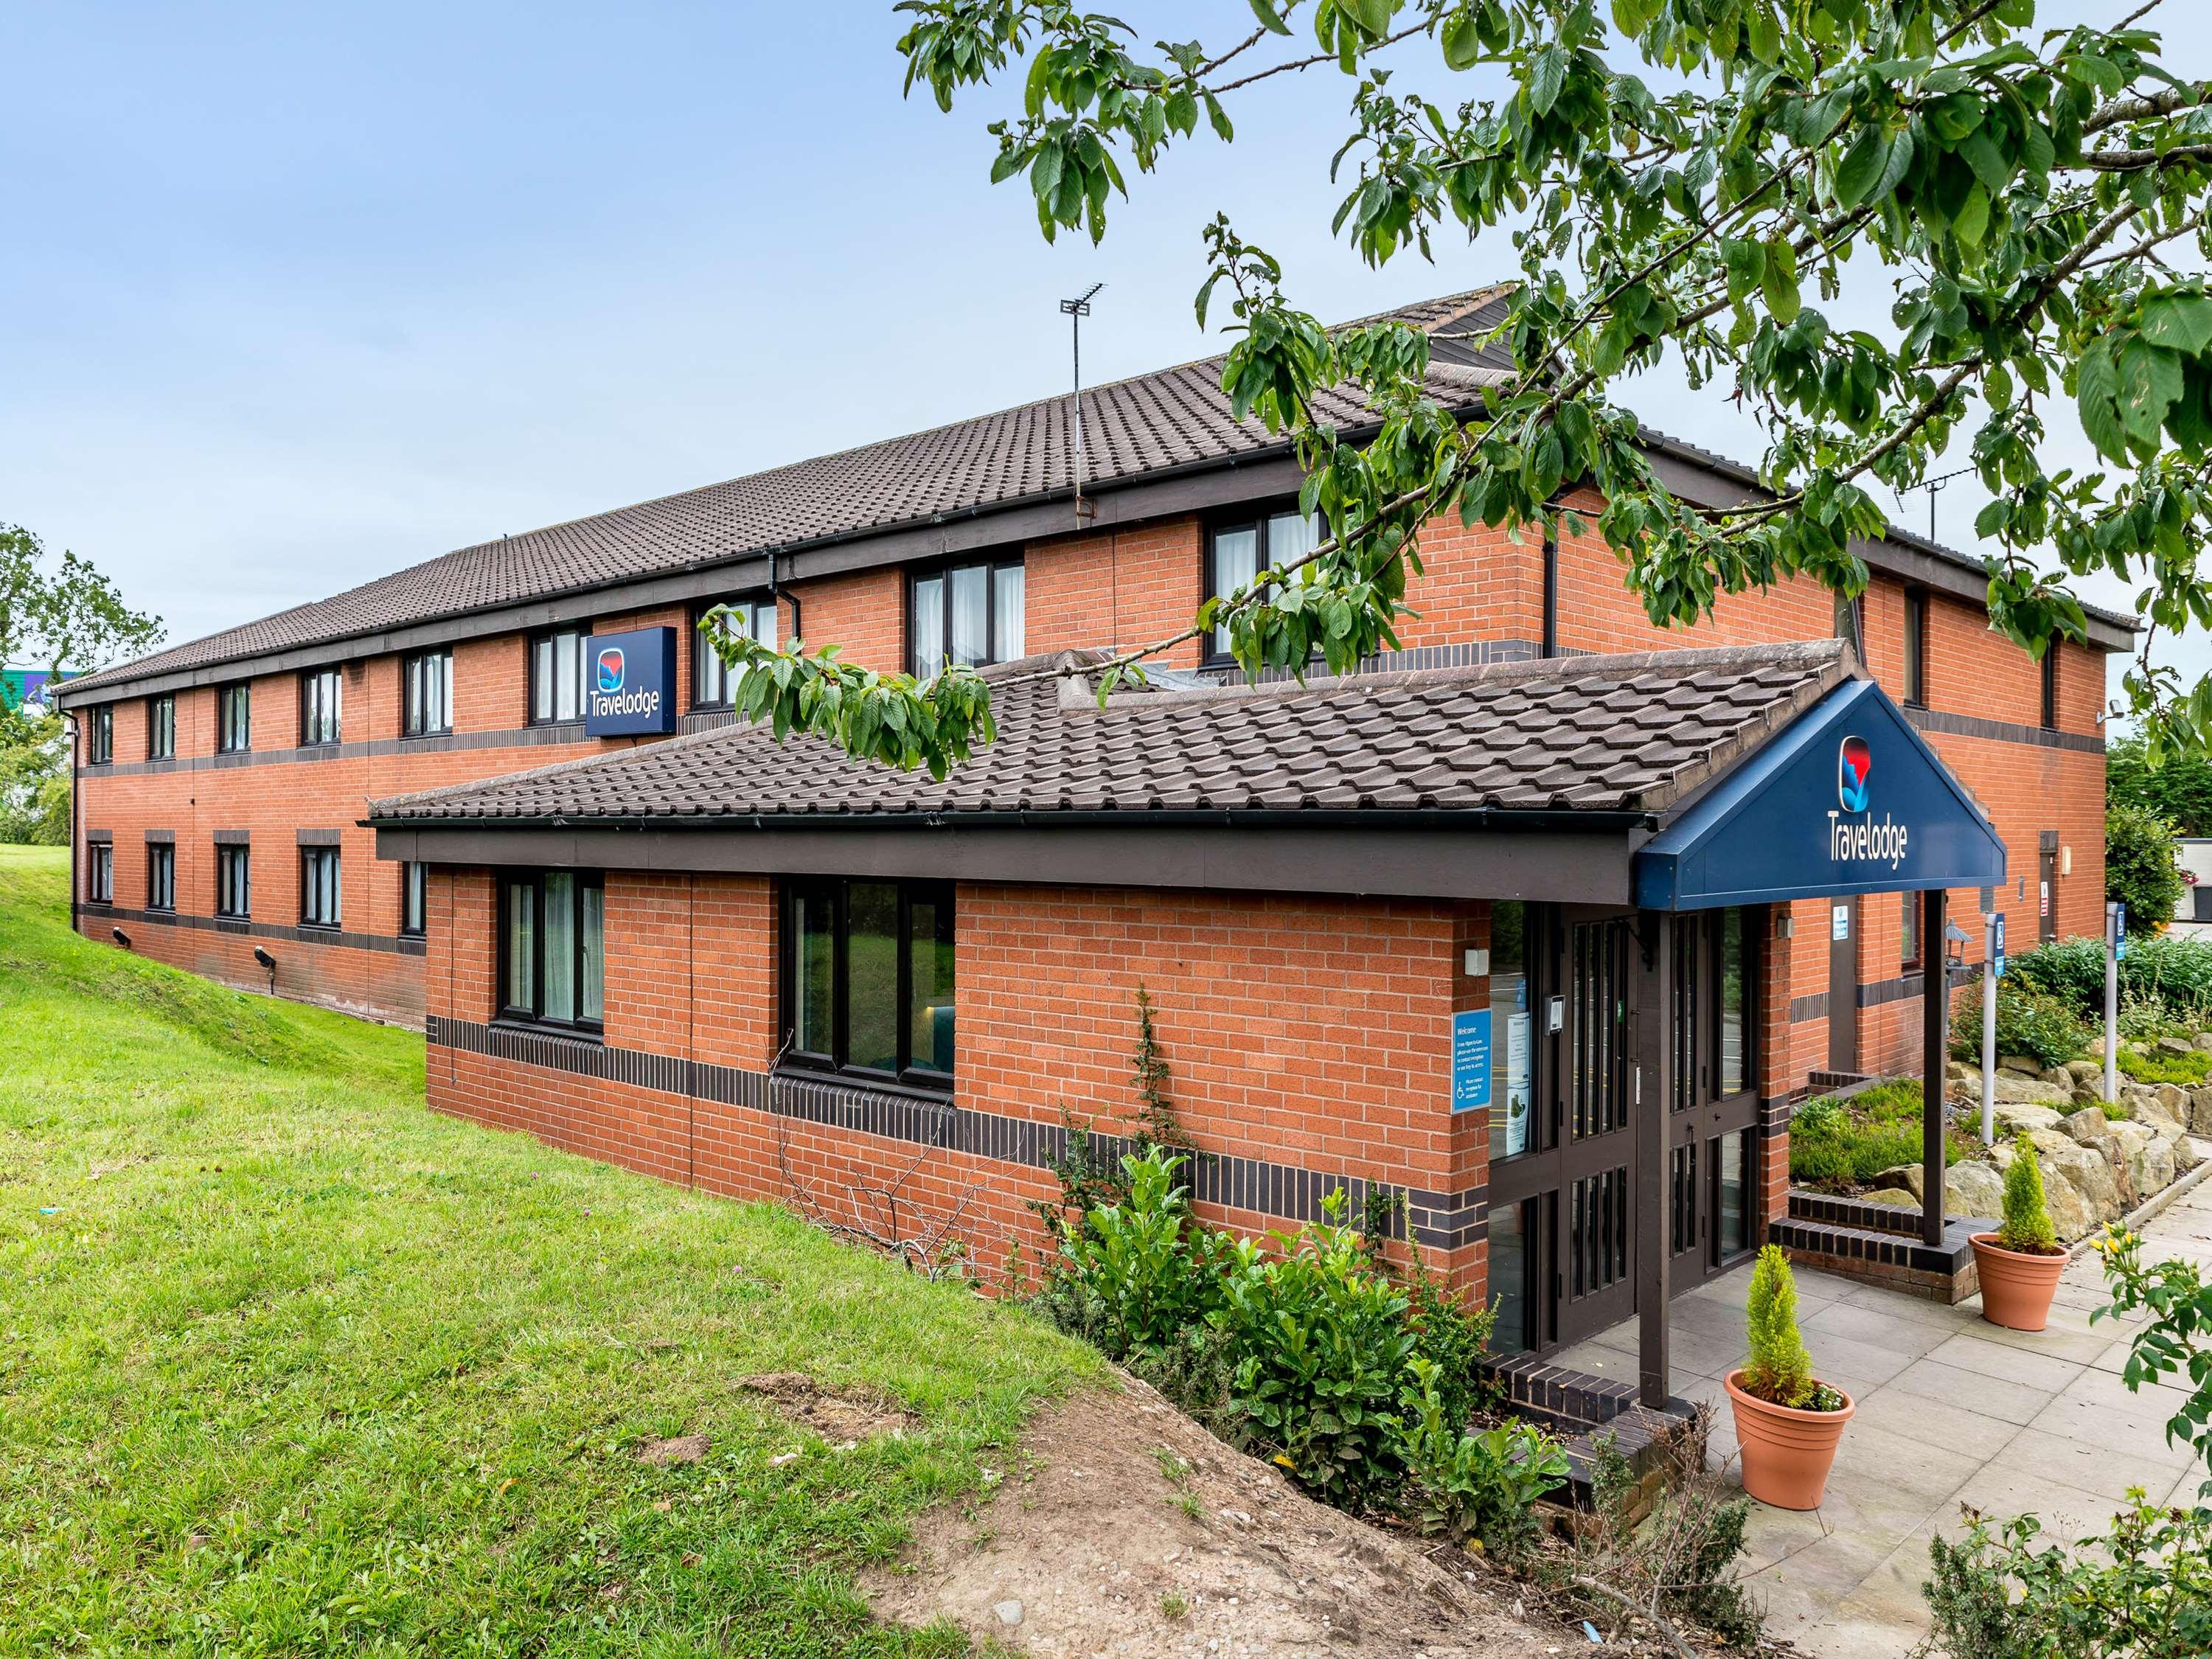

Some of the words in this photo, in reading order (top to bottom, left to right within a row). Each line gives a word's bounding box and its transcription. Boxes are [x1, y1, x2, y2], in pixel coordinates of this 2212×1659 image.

[590, 685, 659, 719] Travelodge
[1827, 810, 1908, 871] Travelodge
[1457, 1026, 1477, 1036] Welcome
